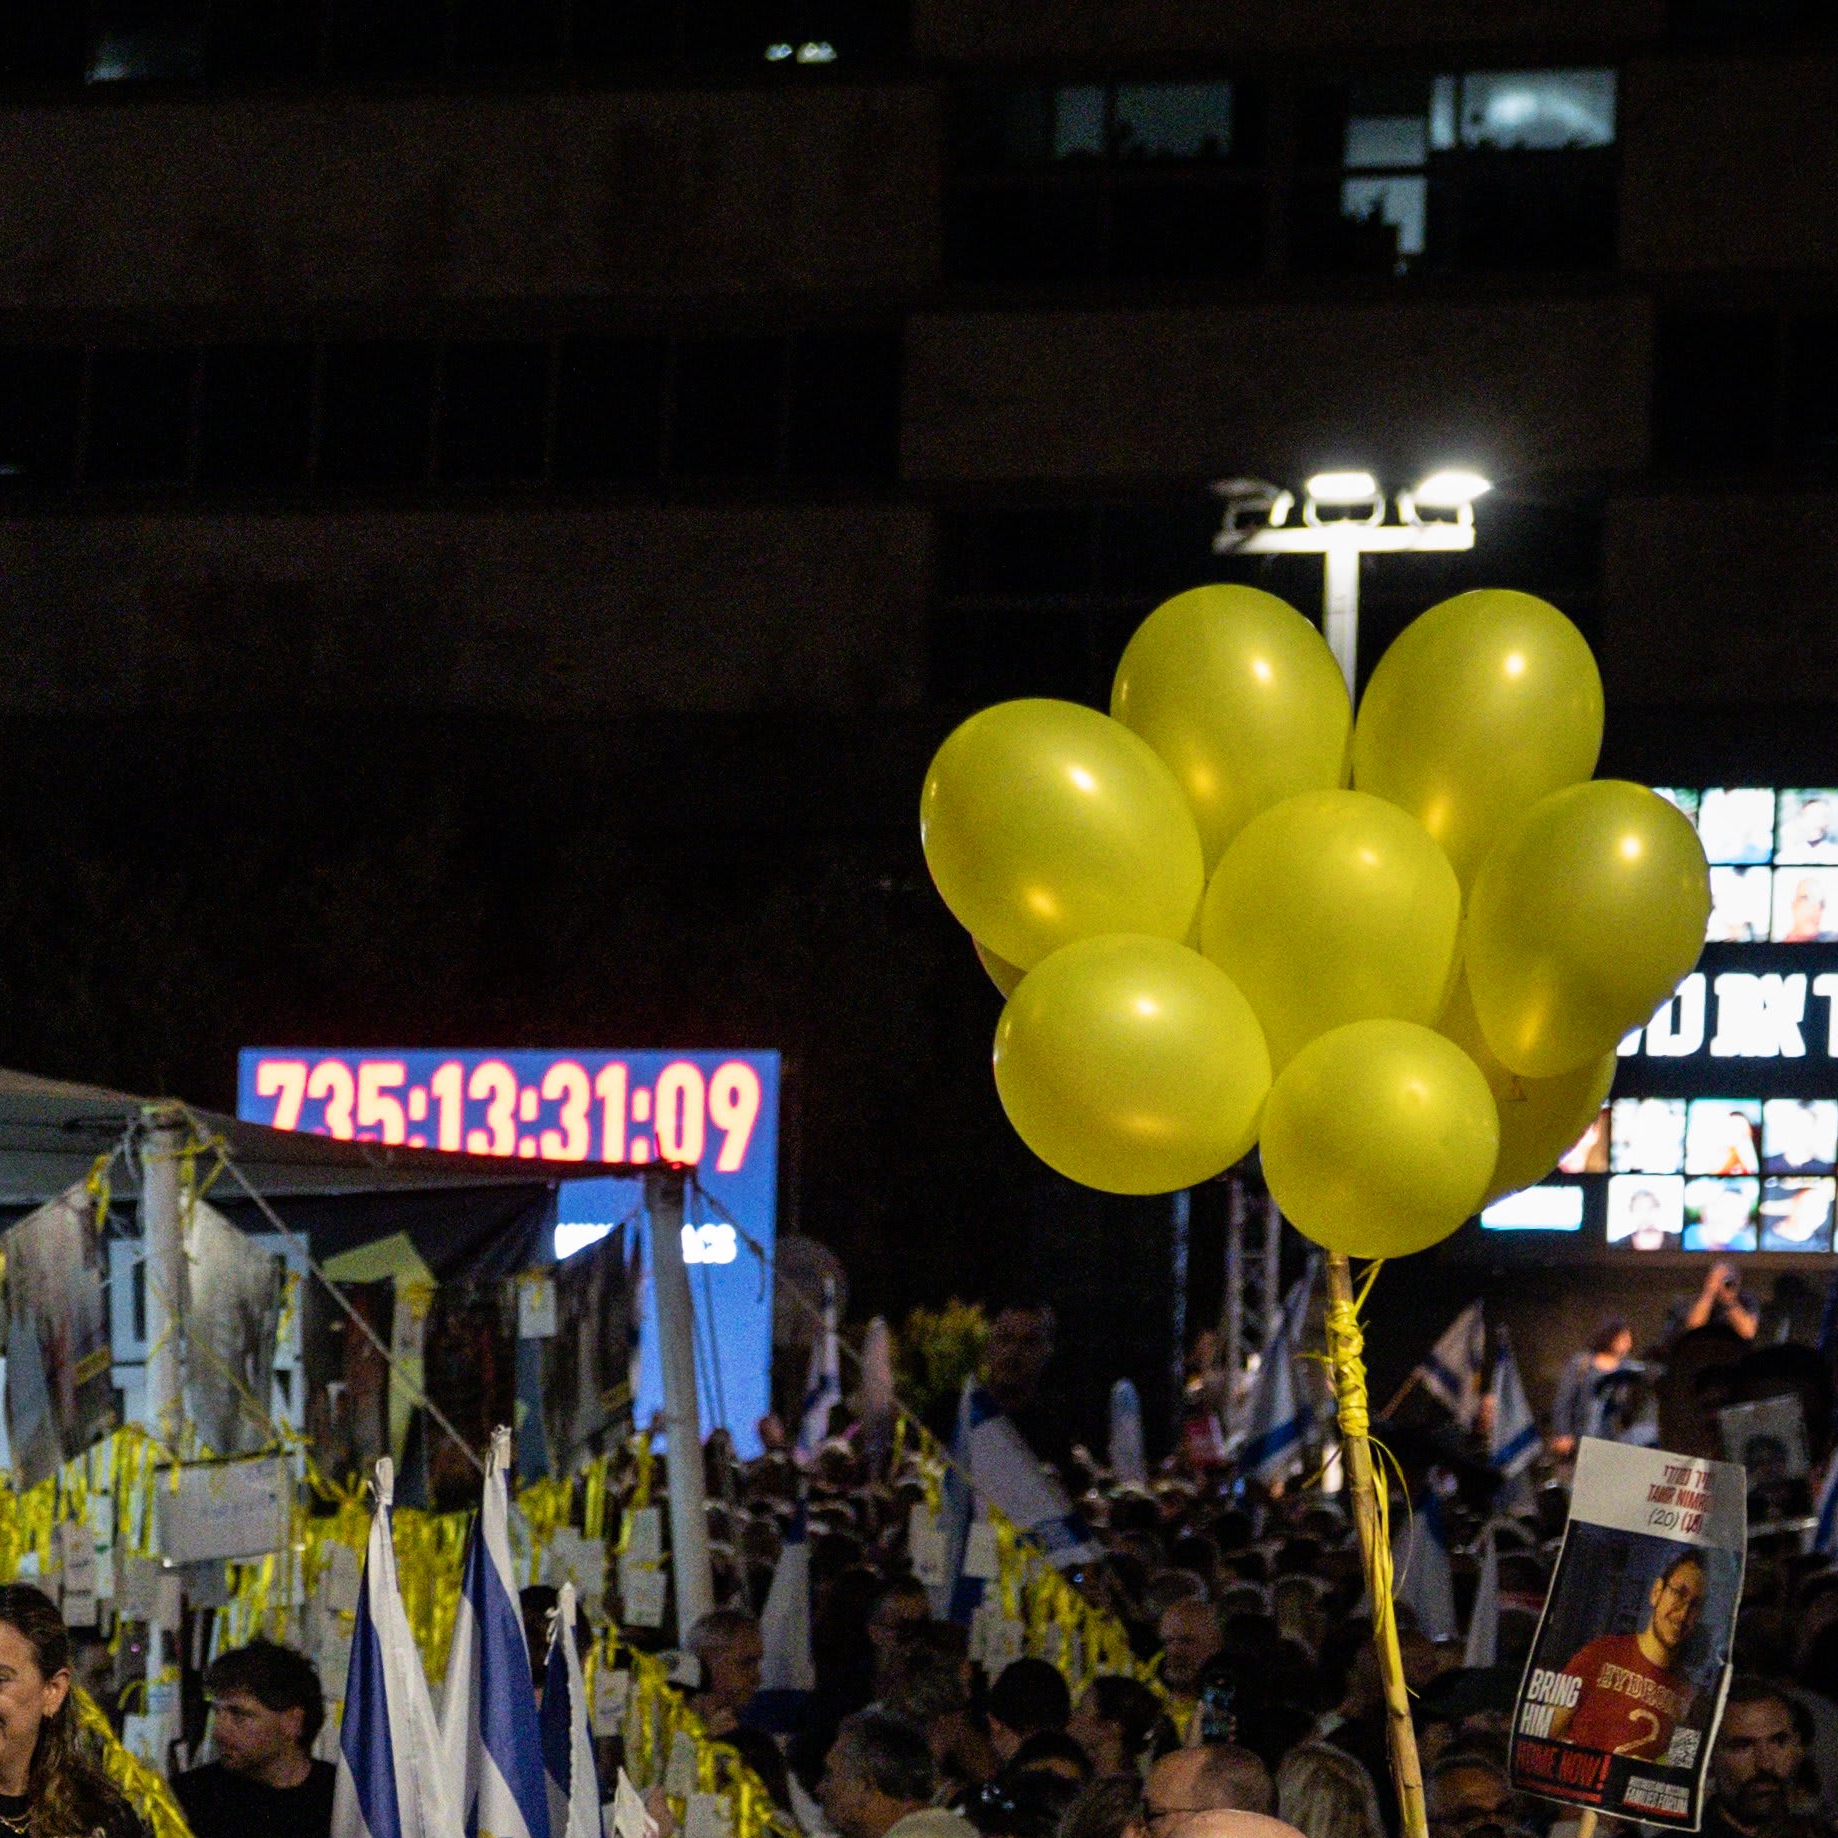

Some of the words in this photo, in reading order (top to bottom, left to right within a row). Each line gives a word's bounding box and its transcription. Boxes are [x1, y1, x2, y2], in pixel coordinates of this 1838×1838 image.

[255, 1060, 761, 1172] 735:13:31:09
[1648, 1508, 1679, 1530] (20)
[1527, 1669, 1582, 1708] BRING
[1519, 1703, 1554, 1738] HIM
